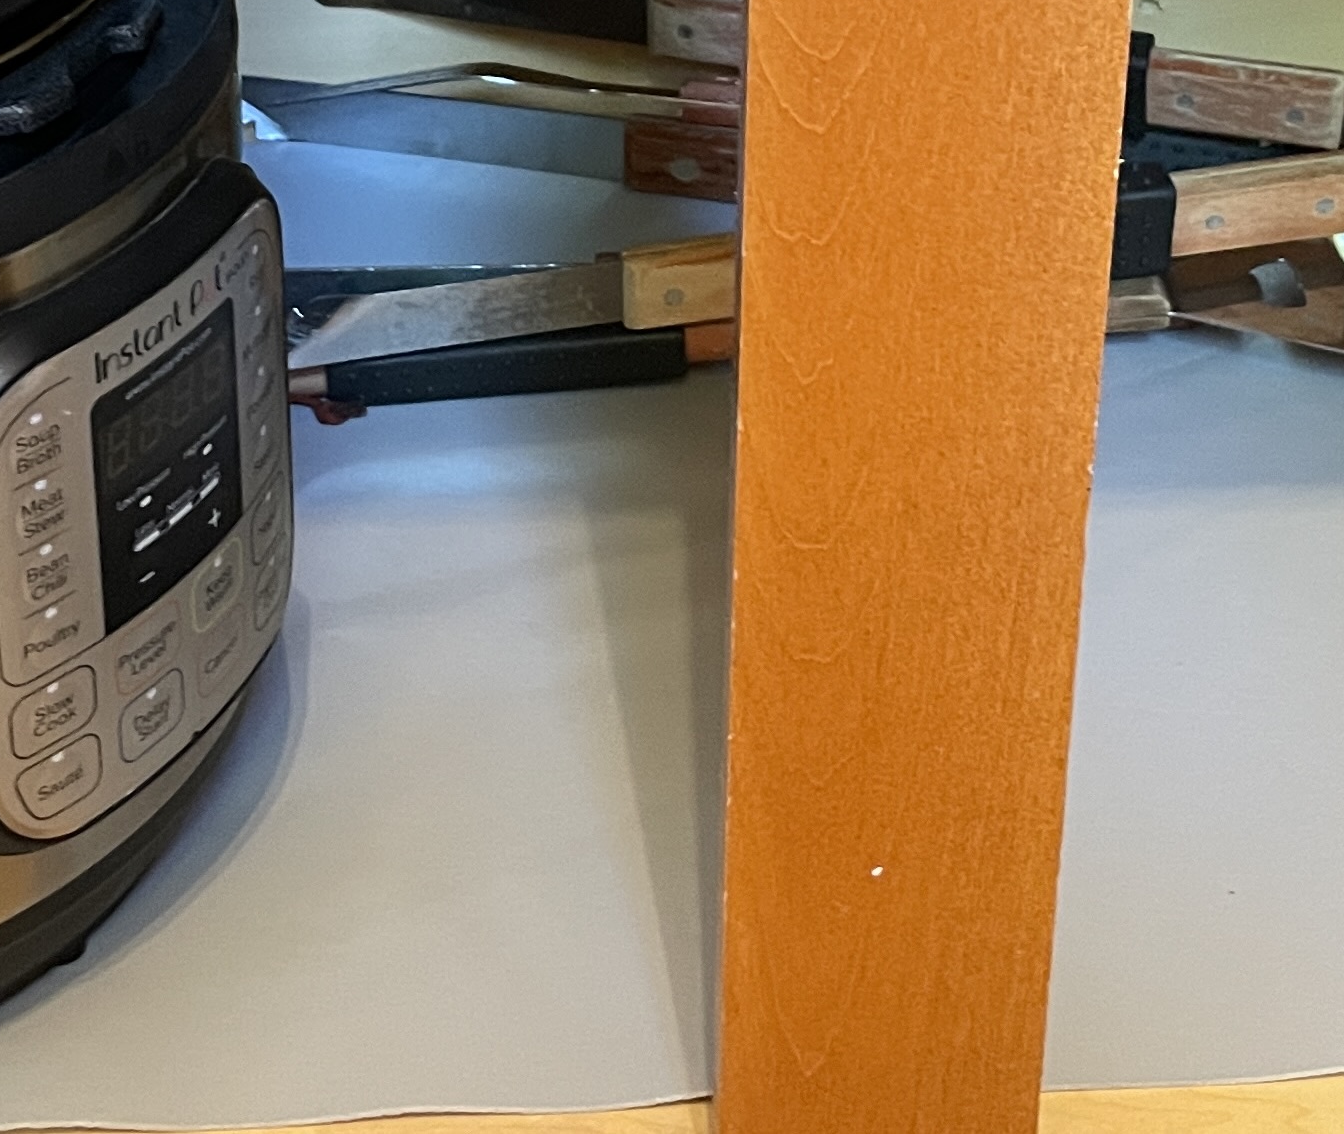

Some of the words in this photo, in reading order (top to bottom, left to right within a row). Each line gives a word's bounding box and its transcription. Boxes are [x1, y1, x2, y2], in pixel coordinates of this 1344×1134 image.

[94, 301, 182, 384] Instant
[16, 424, 61, 453] Soup
[17, 444, 62, 474] Broth
[21, 488, 63, 519] Meat
[24, 509, 65, 539] Stew
[26, 553, 70, 583] Bean
[118, 620, 177, 668] Pressure
[131, 640, 167, 676] Level
[33, 708, 76, 737] Cook
